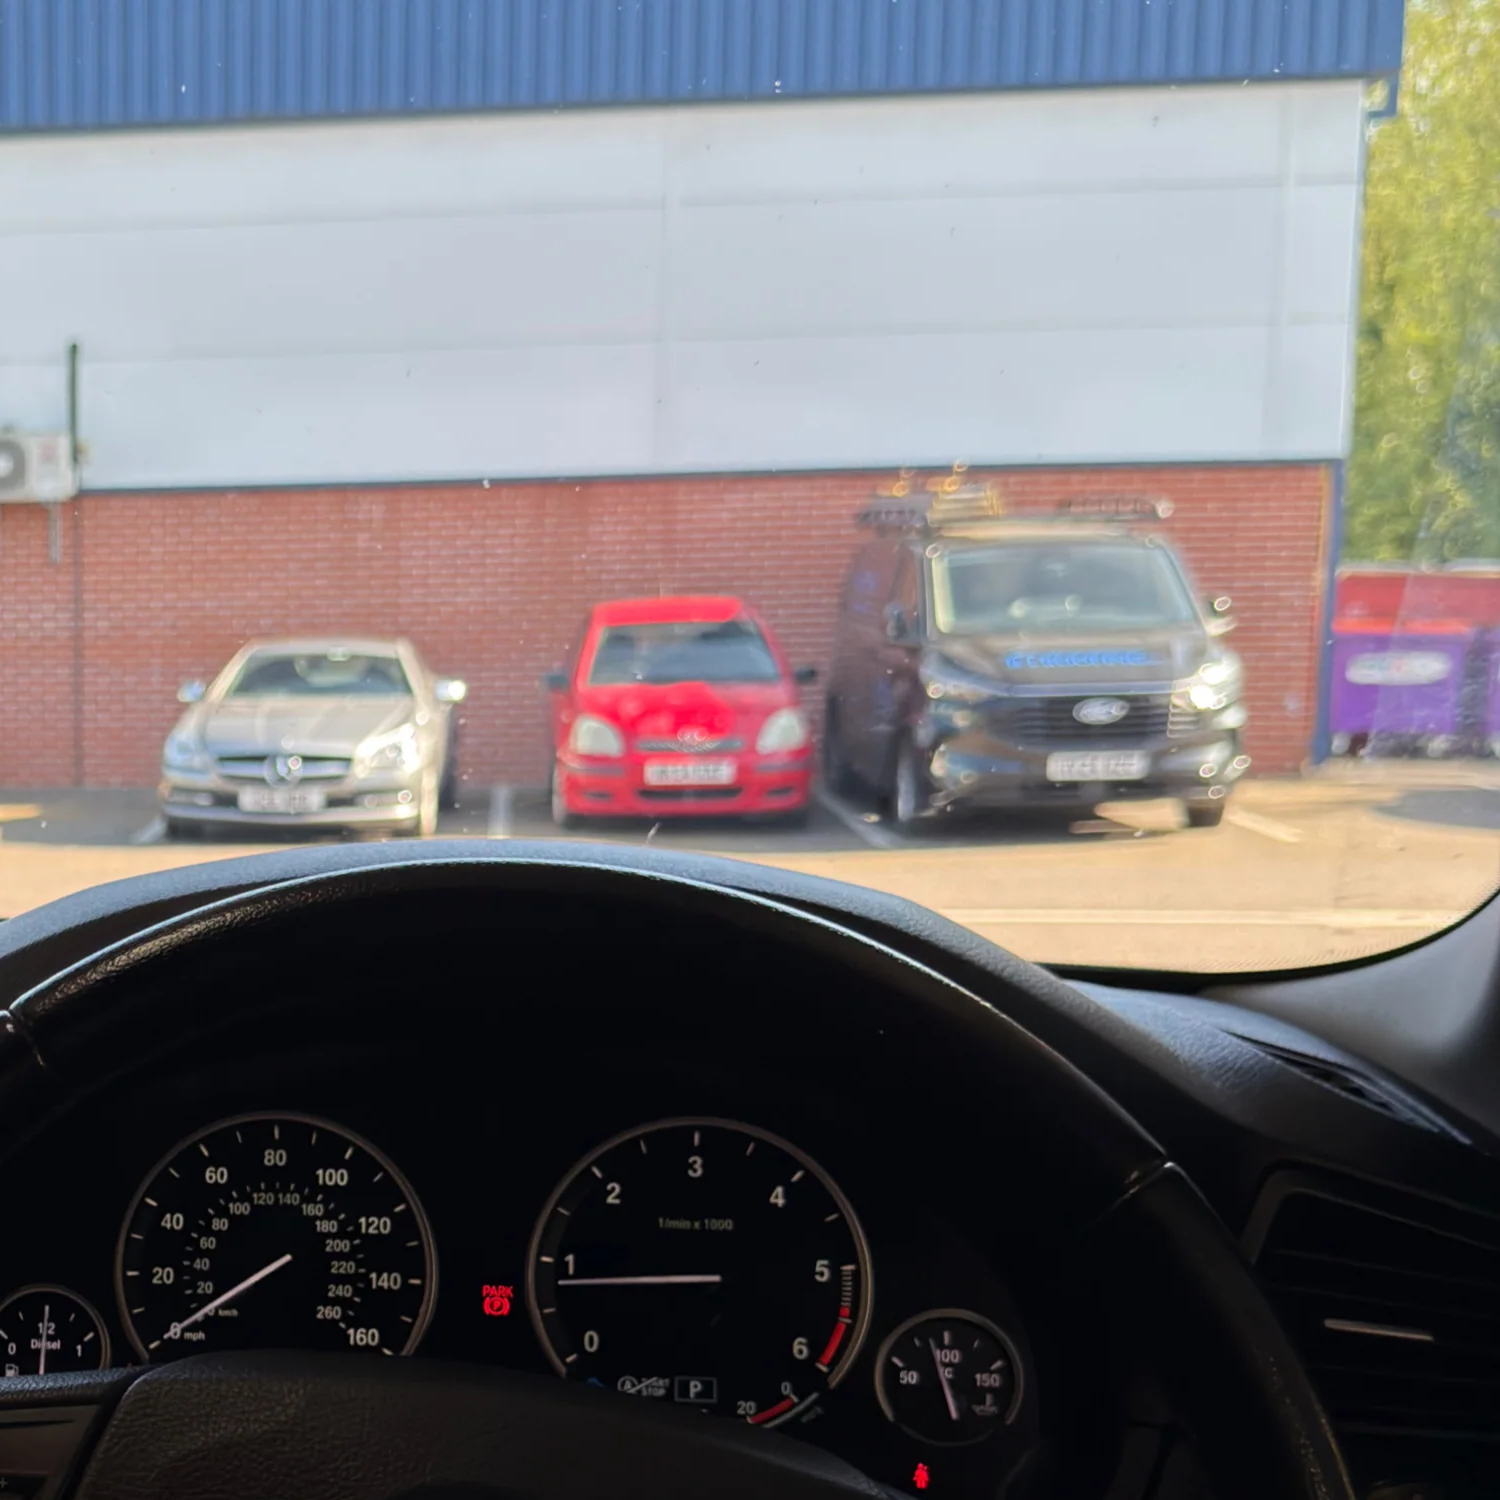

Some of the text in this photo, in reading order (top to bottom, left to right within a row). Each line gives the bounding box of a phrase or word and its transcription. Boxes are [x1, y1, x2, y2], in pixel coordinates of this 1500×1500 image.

[264, 1150, 286, 1166] 80
[687, 1156, 703, 1178] 3
[205, 1167, 228, 1184] 60
[316, 1169, 348, 1186] 100
[252, 1192, 274, 1205] 120
[278, 1192, 300, 1206] 140
[606, 1182, 621, 1204] 2
[769, 1186, 785, 1208] 4
[228, 1202, 250, 1215] 100
[301, 1203, 324, 1216] 160
[161, 1213, 184, 1230] 40
[211, 1218, 228, 1231] 80
[315, 1220, 338, 1233] 180
[358, 1217, 391, 1234] 120
[200, 1236, 216, 1250] 60
[325, 1239, 350, 1252] 200
[193, 1258, 210, 1271] 40
[330, 1261, 356, 1274] 220
[564, 1254, 575, 1276] 1
[814, 1259, 830, 1282] 5
[152, 1267, 174, 1284] 20
[369, 1272, 401, 1290] 140
[197, 1281, 213, 1295] 20
[327, 1285, 352, 1298] 240
[482, 1284, 513, 1298] PARK
[316, 1306, 342, 1320] 260
[30, 1338, 61, 1350] Disel
[347, 1328, 379, 1346] 160
[583, 1331, 599, 1353] 0
[7, 1341, 17, 1355] 0
[76, 1344, 83, 1358] 1
[792, 1337, 808, 1359] 6
[935, 1348, 960, 1364] 100
[899, 1370, 919, 1385] 50
[975, 1373, 1001, 1388] 150
[689, 1380, 703, 1399] P
[781, 1381, 793, 1395] 0
[737, 1401, 756, 1415] 20
